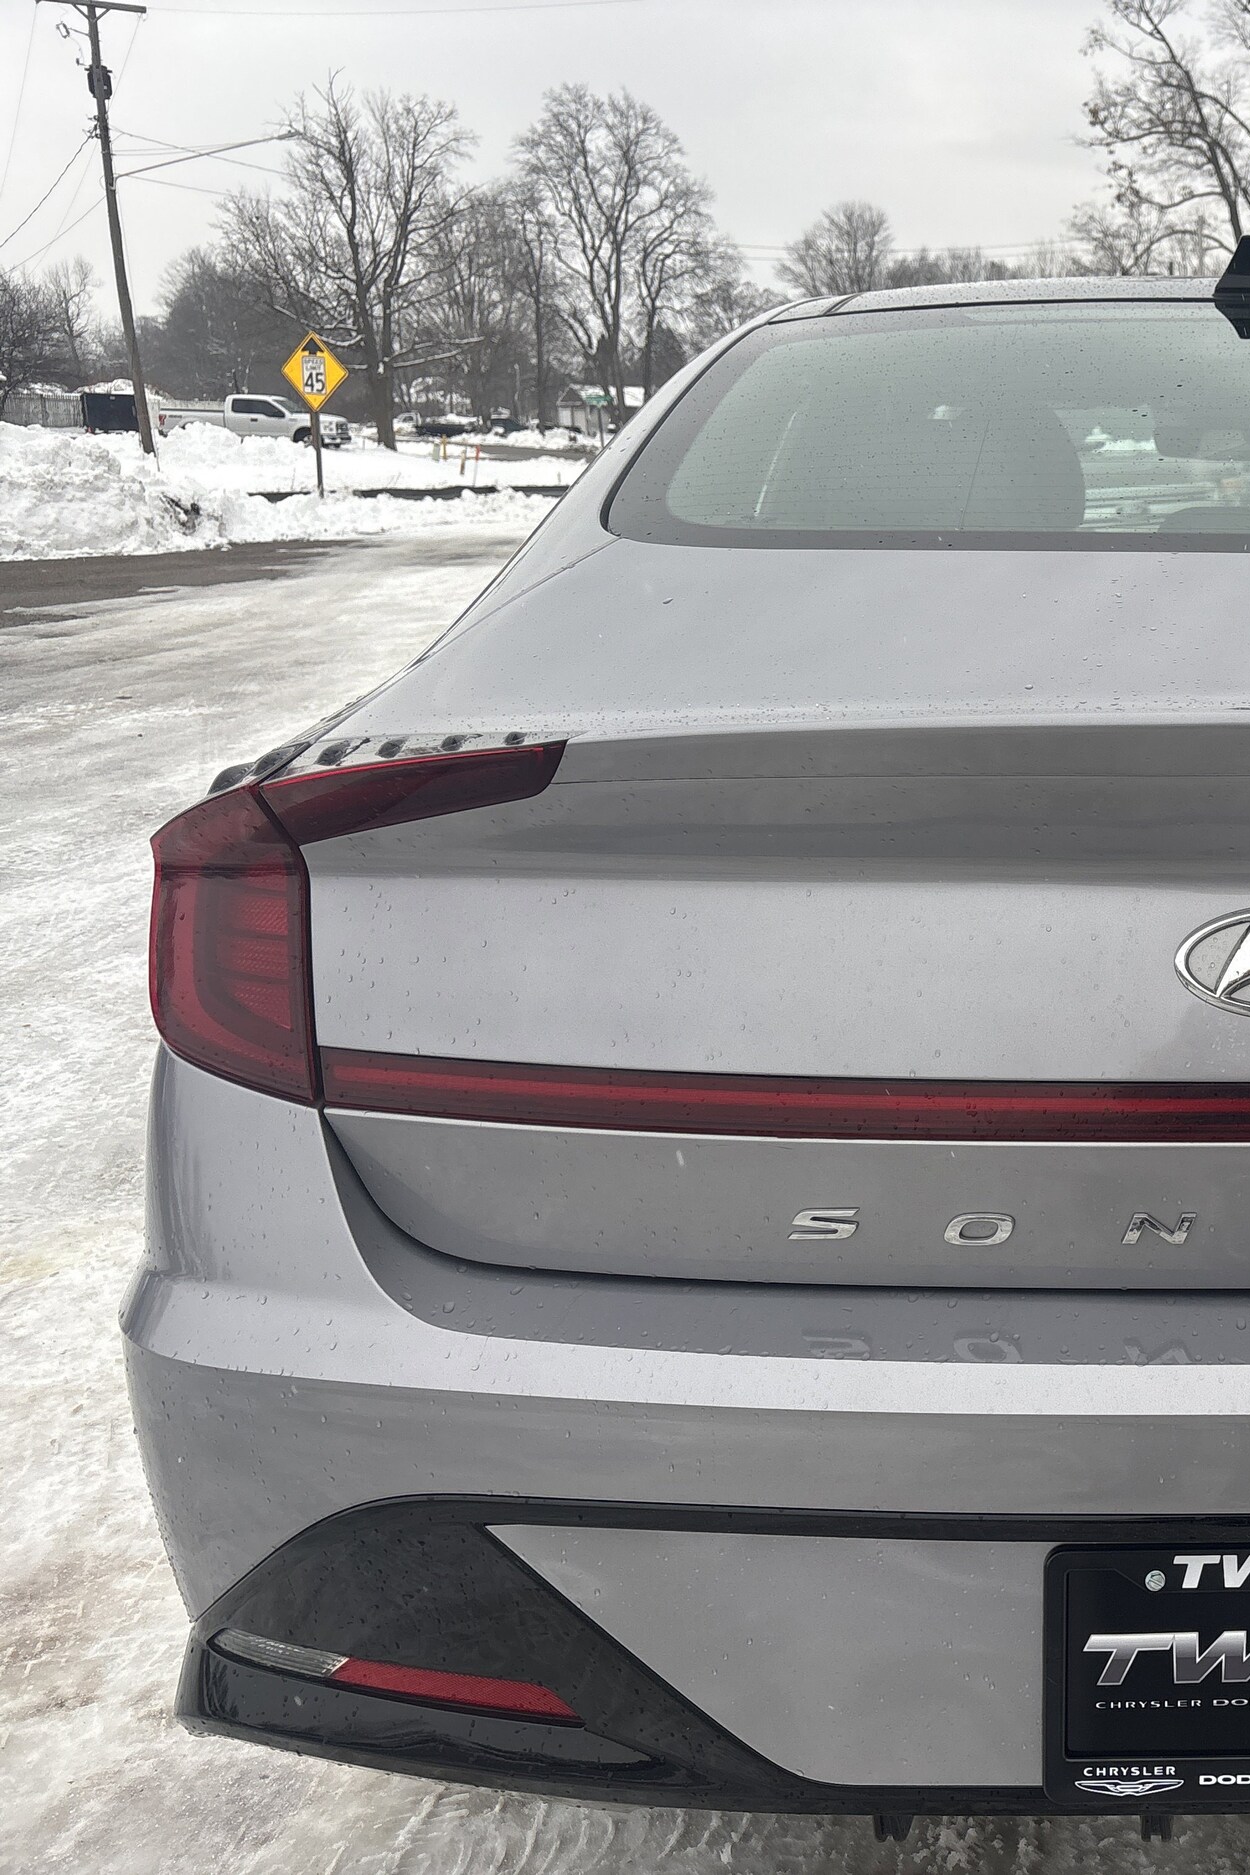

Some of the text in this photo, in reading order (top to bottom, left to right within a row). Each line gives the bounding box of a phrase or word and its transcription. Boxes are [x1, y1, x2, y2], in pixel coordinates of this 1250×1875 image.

[304, 371, 325, 392] 45
[1095, 1699, 1202, 1709] CHRYSLER
[1083, 1766, 1176, 1777] CHRYSLER
